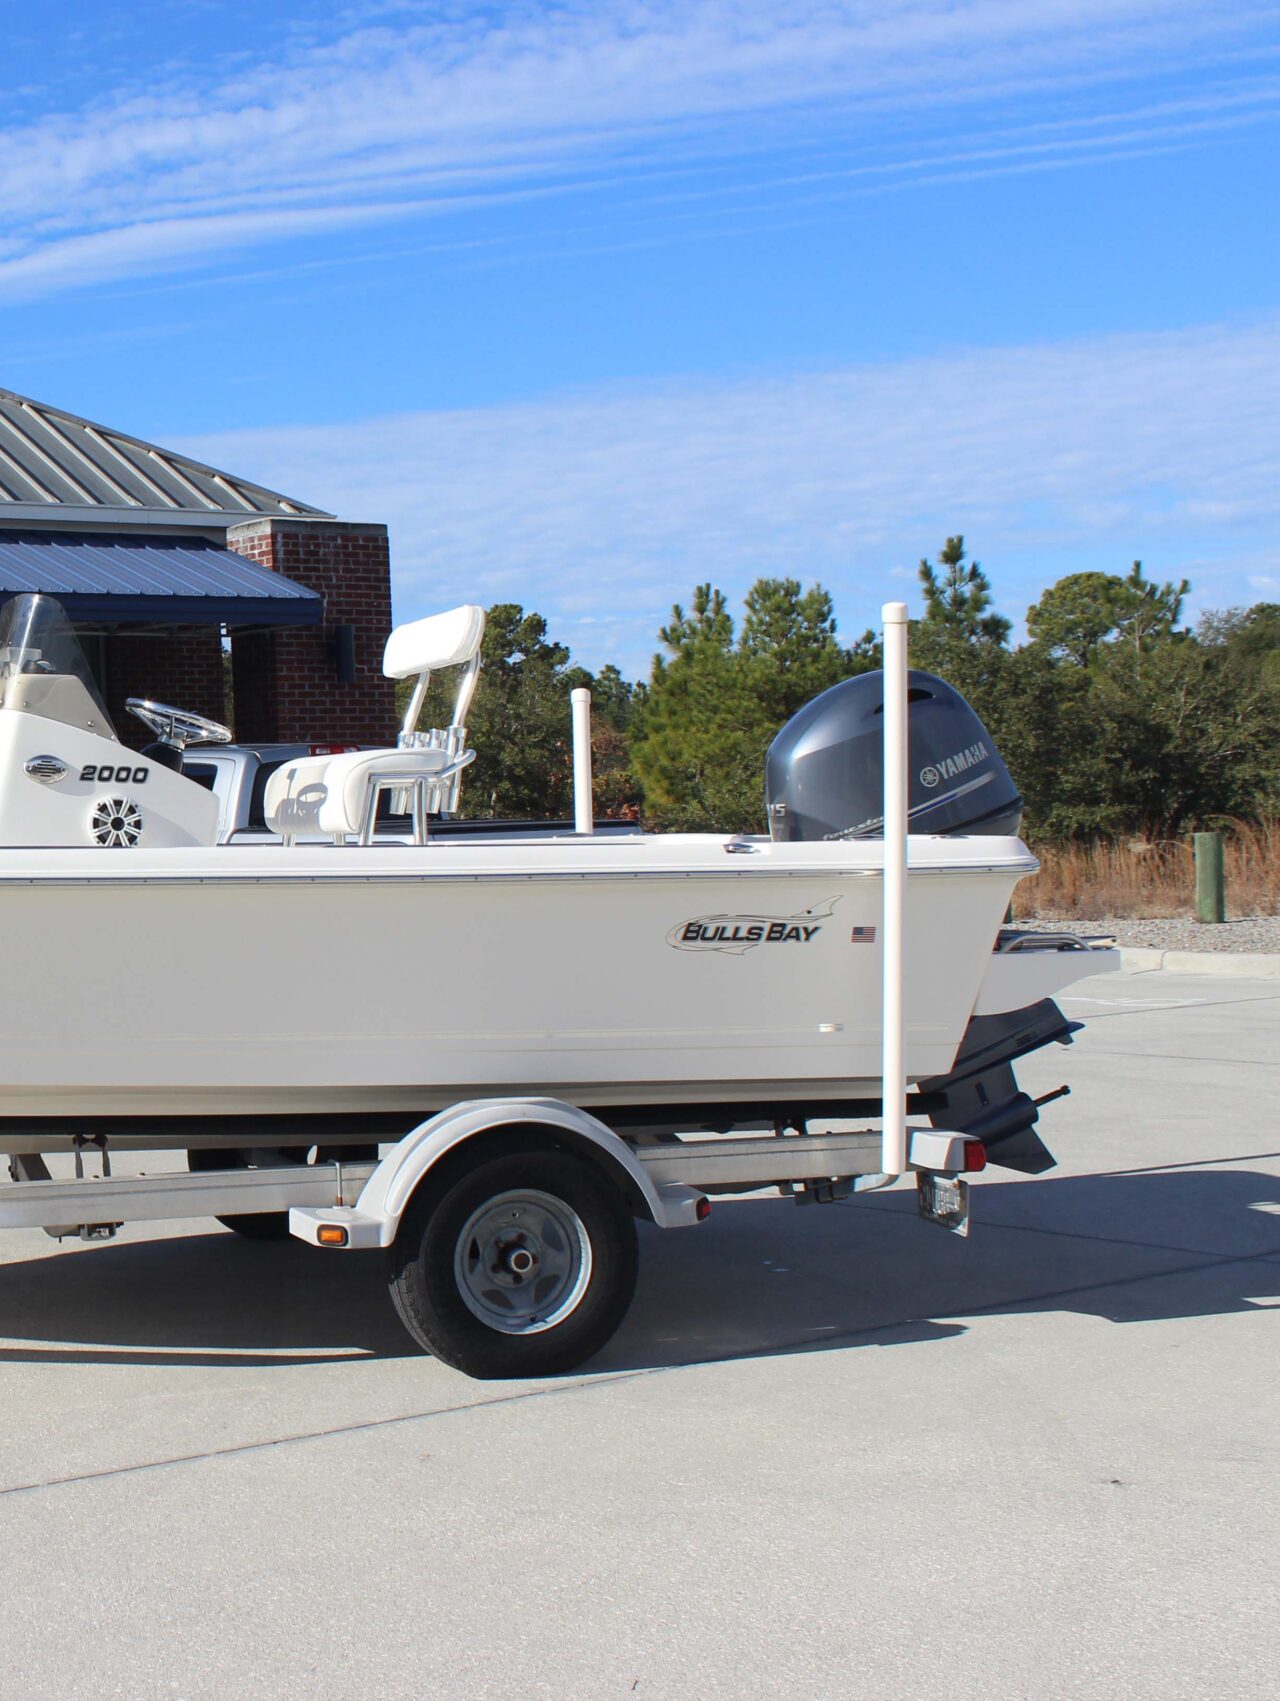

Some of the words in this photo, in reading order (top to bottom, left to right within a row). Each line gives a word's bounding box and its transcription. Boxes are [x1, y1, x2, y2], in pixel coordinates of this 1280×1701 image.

[936, 741, 989, 780] YAMAHA
[80, 765, 149, 784] 2000
[681, 922, 764, 942] BULLS
[765, 922, 821, 942] BAY
